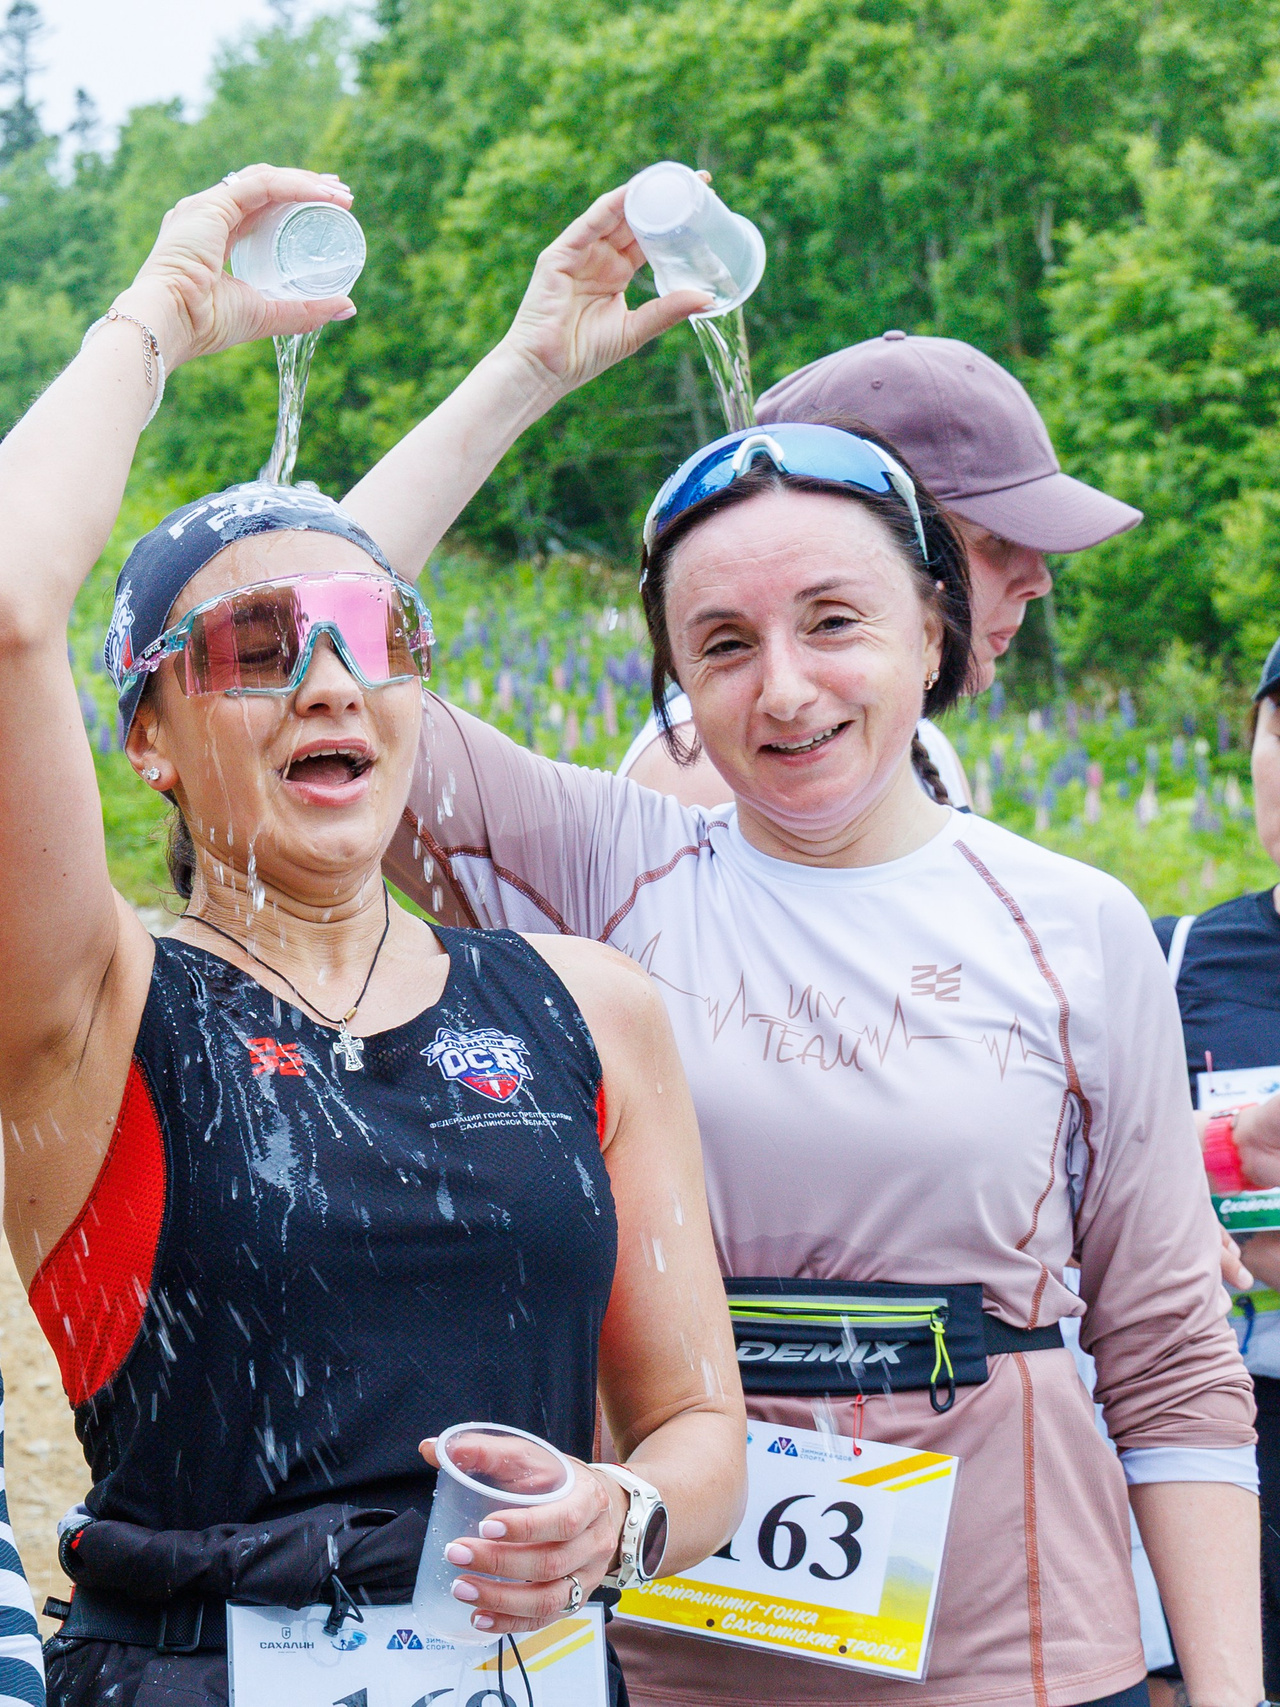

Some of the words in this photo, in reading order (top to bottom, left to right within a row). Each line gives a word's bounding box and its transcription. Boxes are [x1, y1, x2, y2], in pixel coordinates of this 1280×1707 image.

[758, 1018, 864, 1072] TEAM
[440, 1047, 532, 1079] OCR
[429, 1114, 482, 1129] ФЕДЕРАЦИЯ
[484, 1111, 510, 1120] ГОНОК
[460, 1119, 521, 1131] САХАЛИНСКОЙ
[736, 1340, 910, 1364] DEMIX
[711, 1494, 864, 1581] 63
[259, 1641, 315, 1650] САХАЛИН
